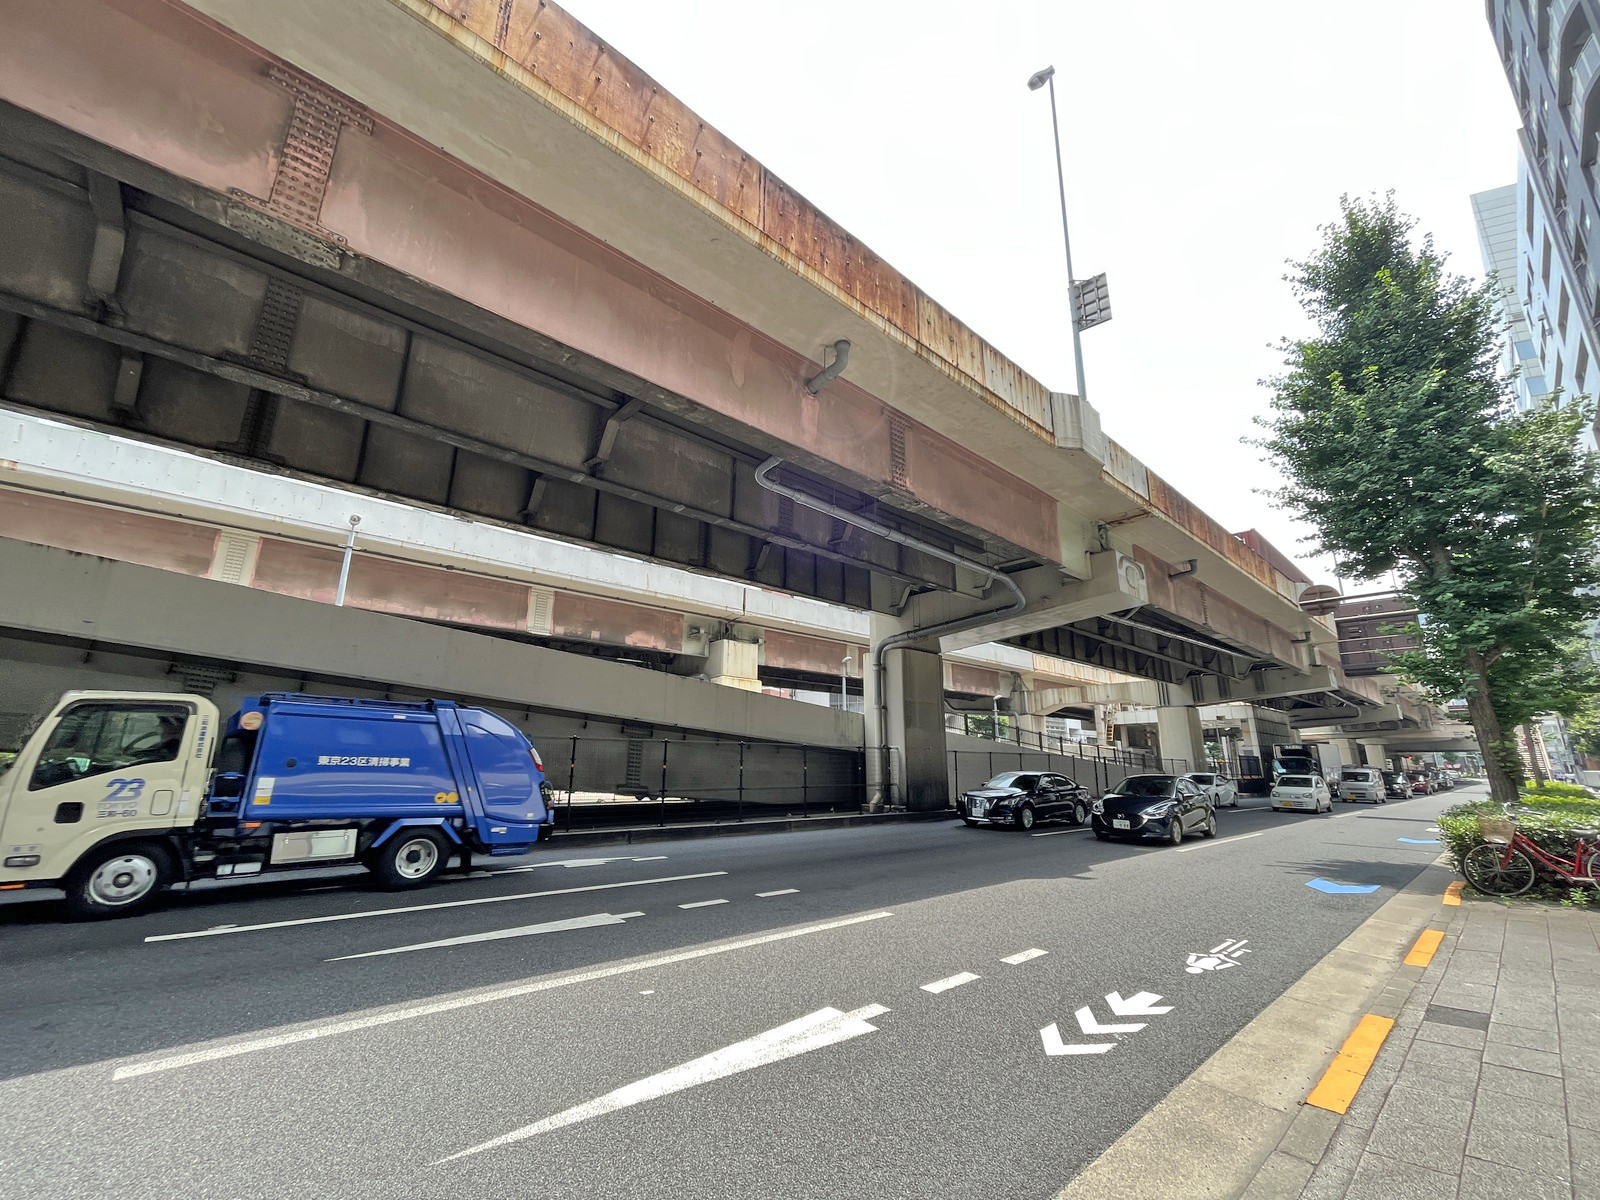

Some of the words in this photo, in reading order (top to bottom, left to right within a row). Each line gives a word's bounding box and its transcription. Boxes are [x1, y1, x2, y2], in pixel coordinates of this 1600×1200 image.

[317, 755, 411, 767] 東京23区清掃事業
[99, 778, 146, 802] 23
